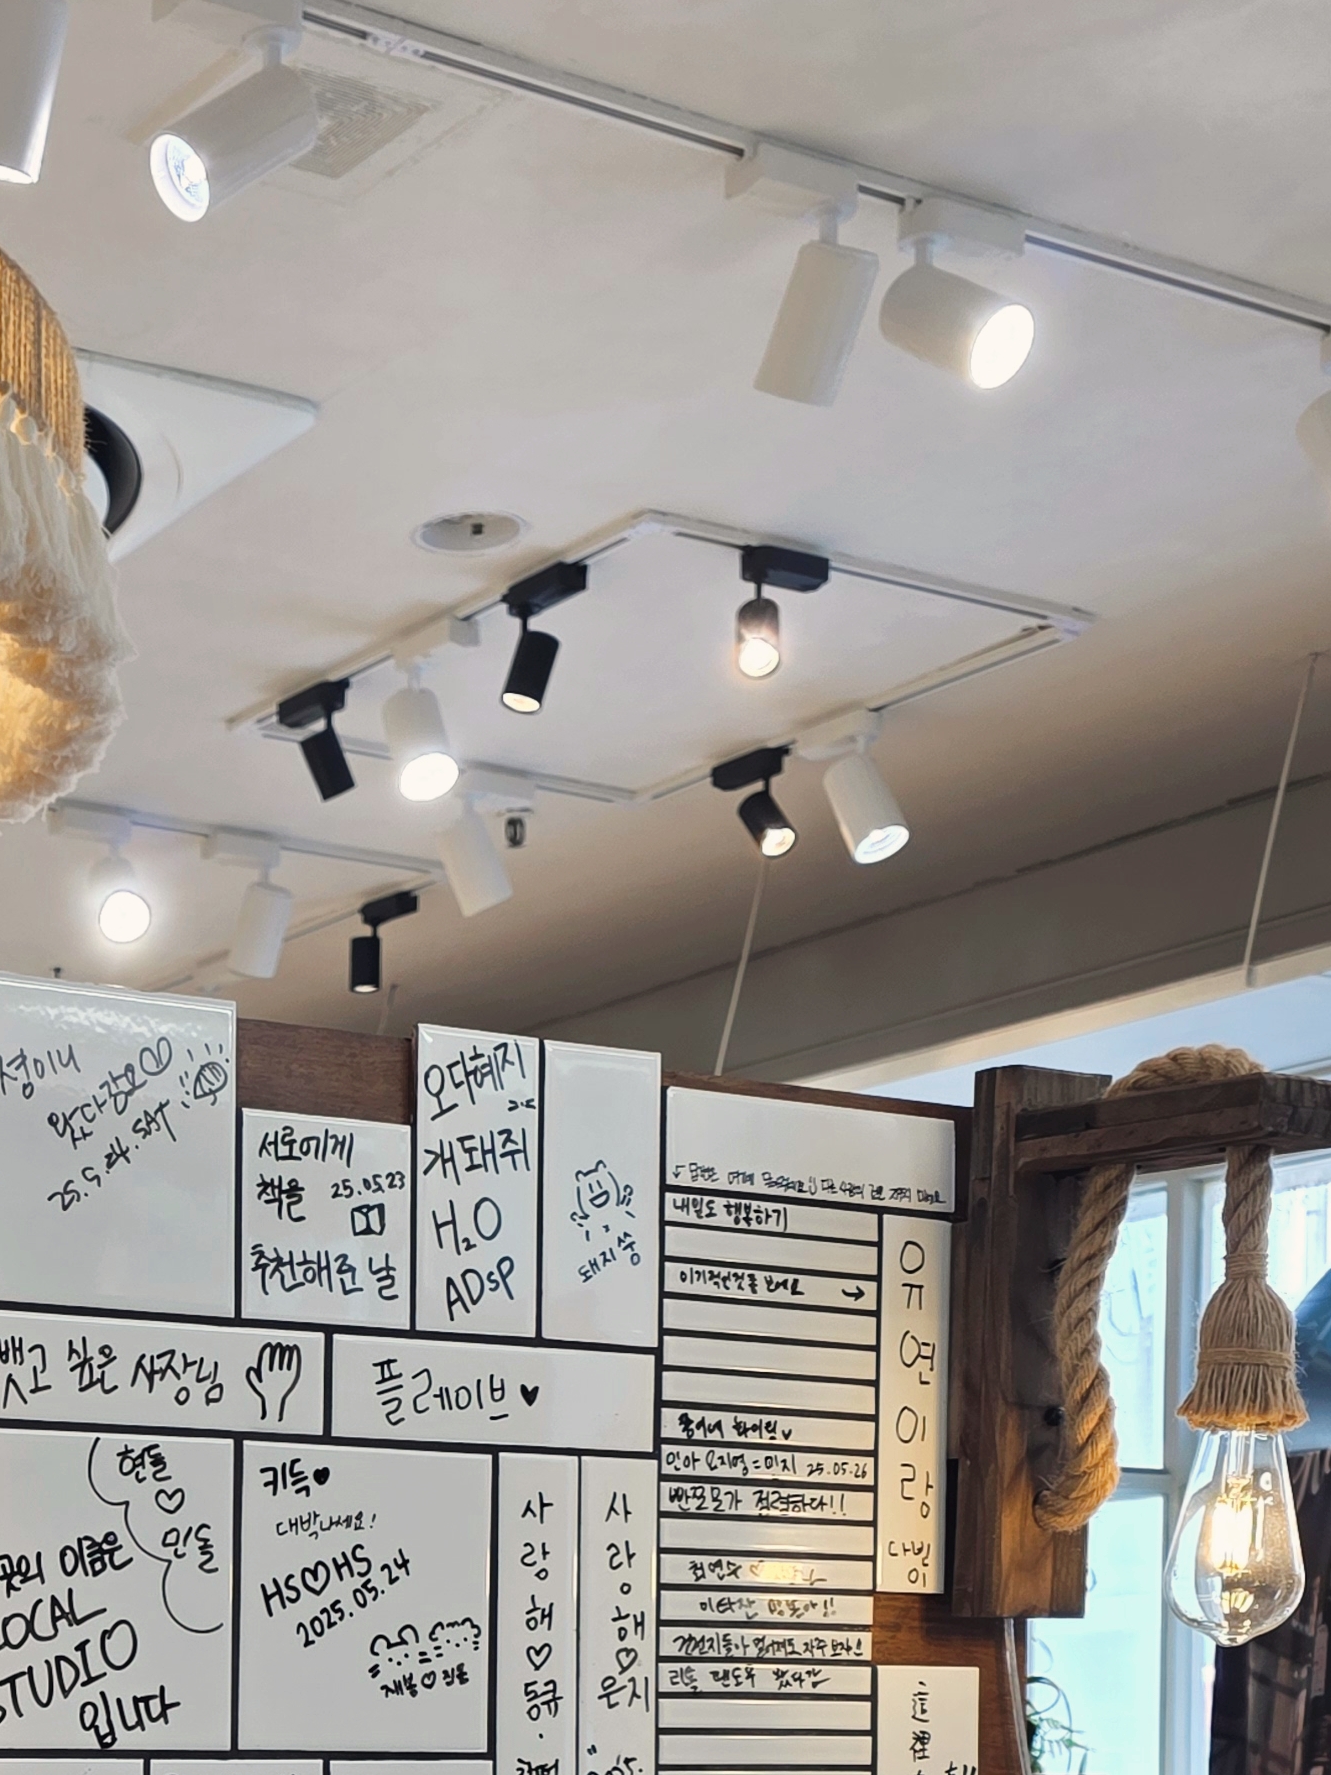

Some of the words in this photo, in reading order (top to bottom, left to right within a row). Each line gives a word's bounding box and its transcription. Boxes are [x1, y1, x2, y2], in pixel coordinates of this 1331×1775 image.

[257, 1125, 356, 1169] 서로에게
[255, 1173, 308, 1224] 책을
[672, 1196, 718, 1220] 내일도
[722, 1199, 789, 1233] 행복하기
[249, 1241, 365, 1297] 추천해준
[367, 1253, 400, 1302] 날
[66, 1338, 118, 1396] 싶은
[130, 1348, 225, 1408] 사장님
[370, 1356, 511, 1427] 플레이브
[58, 1530, 134, 1578] 이름은
[259, 1572, 303, 1619] HS
[331, 1542, 373, 1583] HS
[520, 1490, 556, 1633] 사랑해
[603, 1490, 648, 1645] 사랑해
[295, 1547, 412, 1649] 2025.05.24
[78, 1683, 182, 1750] 입니다
[597, 1674, 651, 1715] 은지
